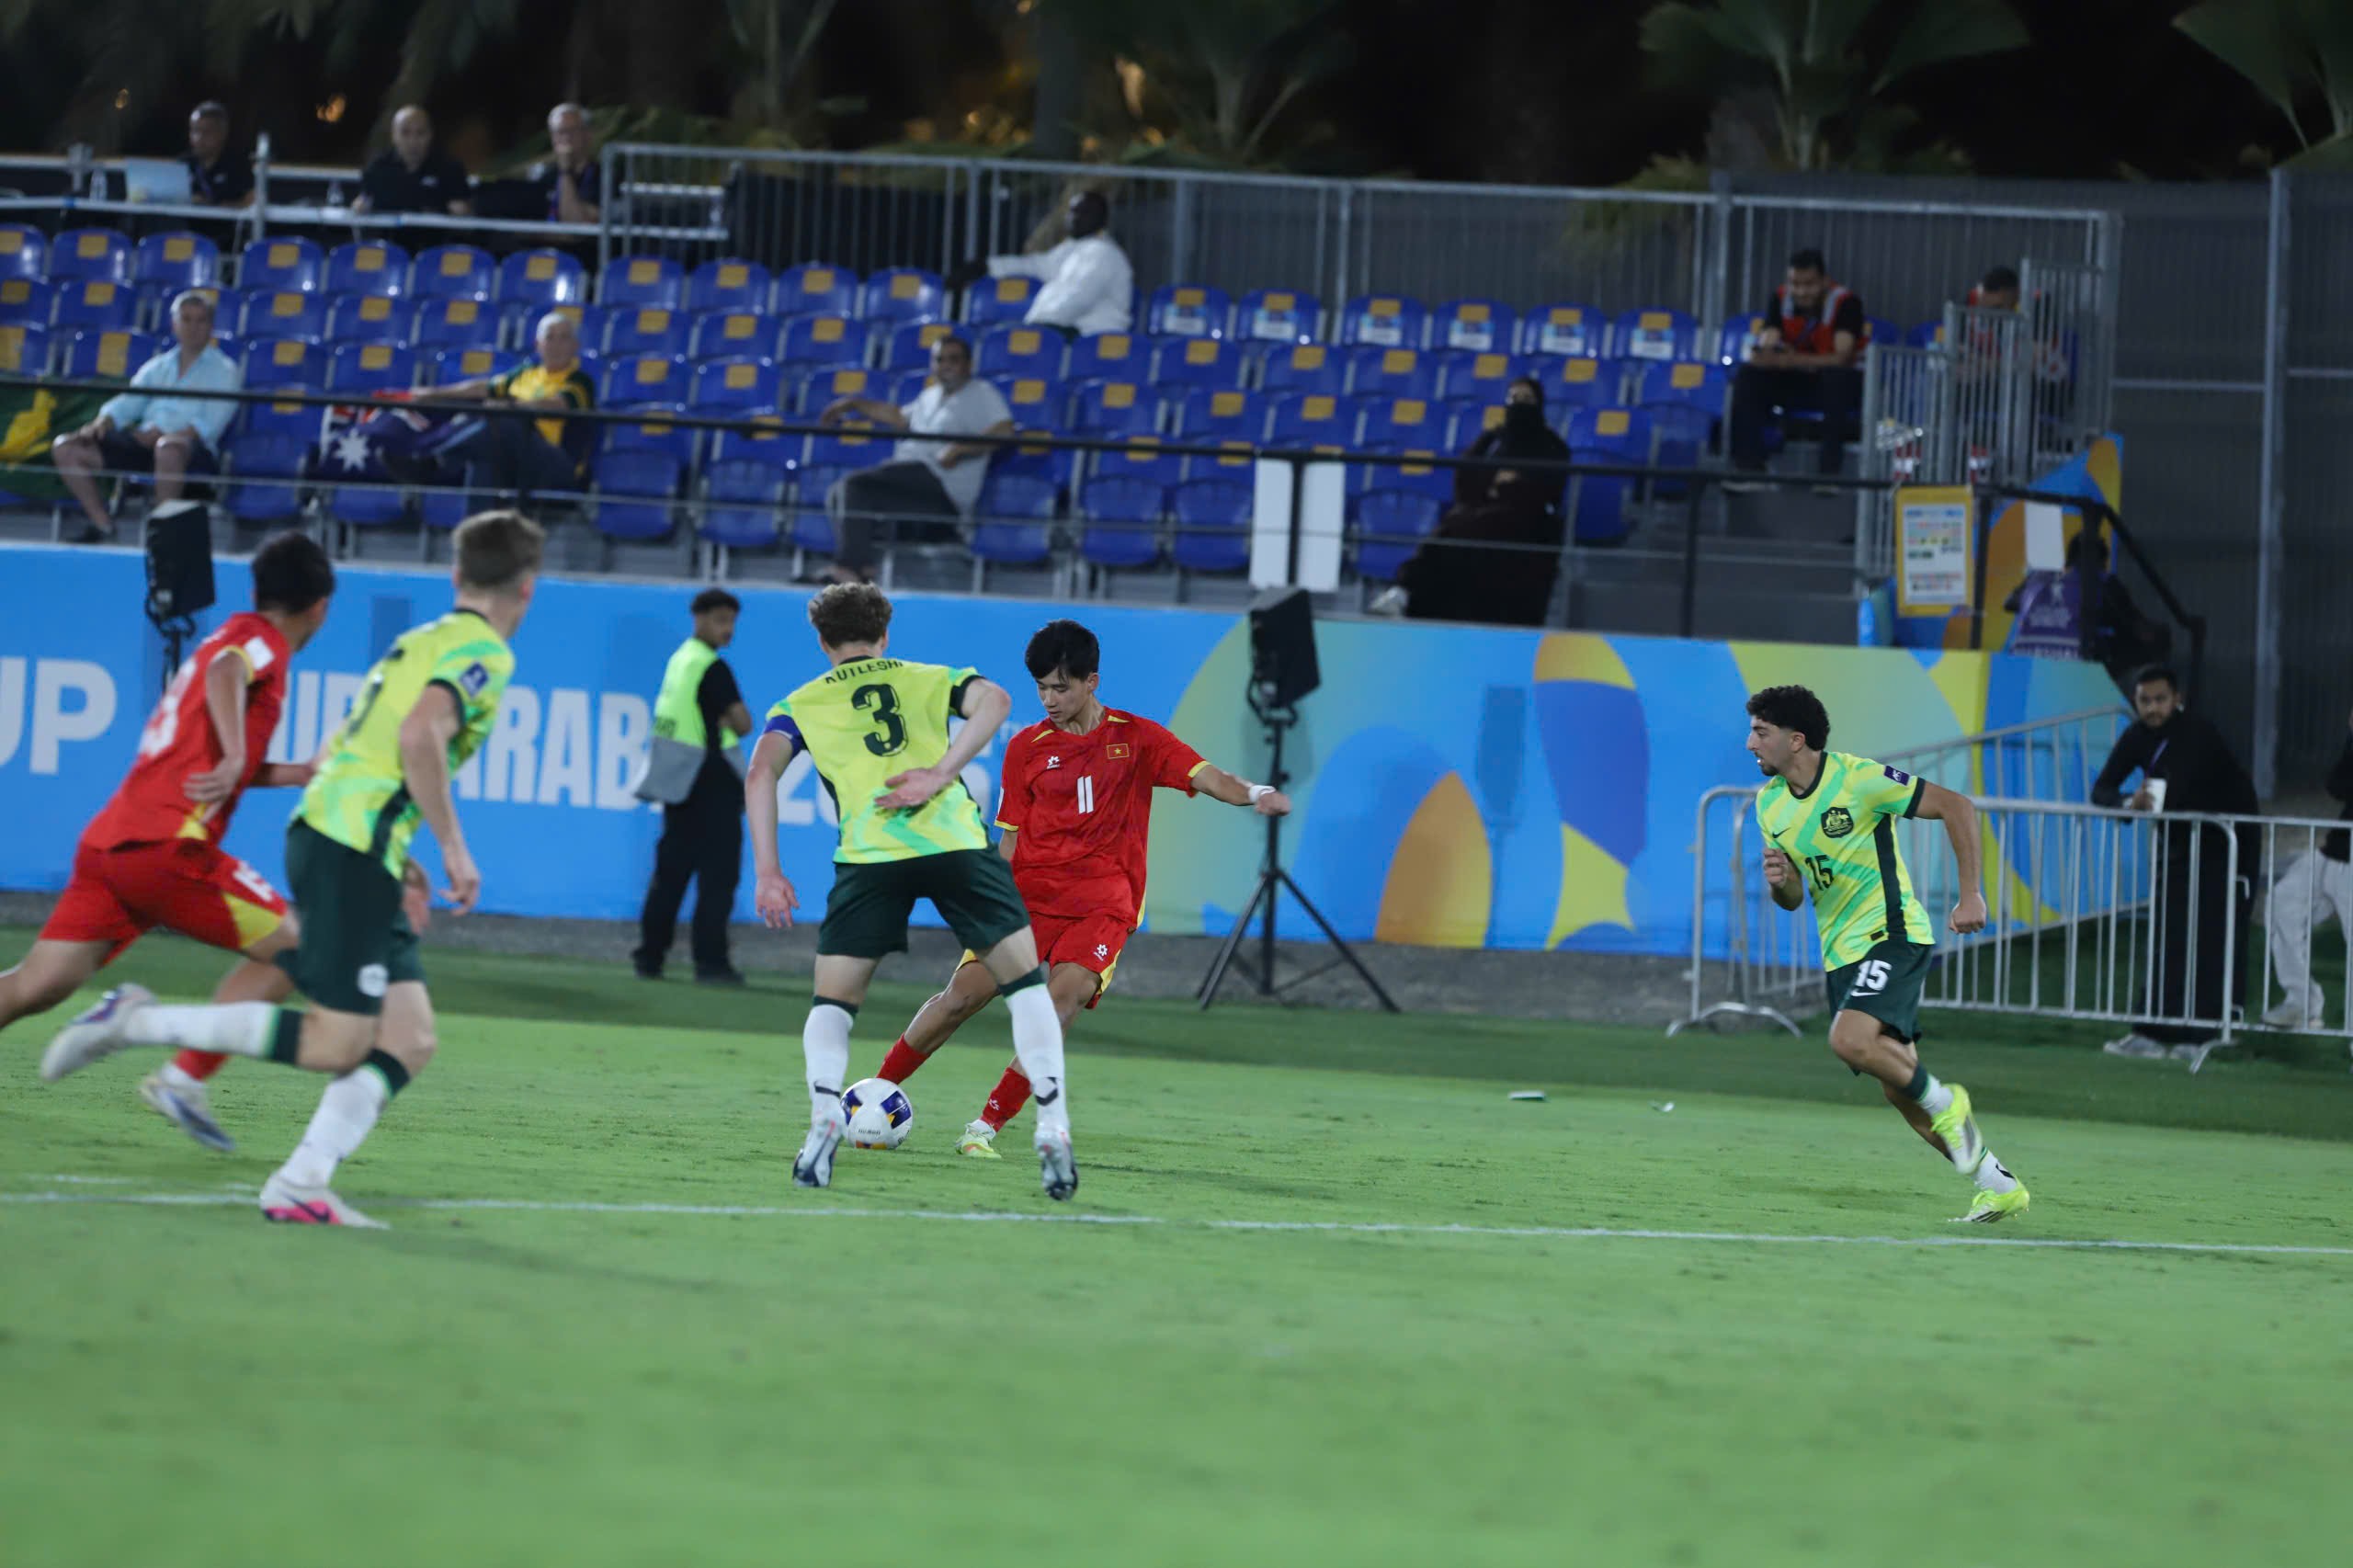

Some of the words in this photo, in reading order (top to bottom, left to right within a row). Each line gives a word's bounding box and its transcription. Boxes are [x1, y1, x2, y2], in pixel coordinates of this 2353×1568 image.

[851, 683, 909, 757] 3
[1076, 775, 1095, 814] 11
[1805, 854, 1835, 891] 15
[1855, 959, 1893, 992] 15
